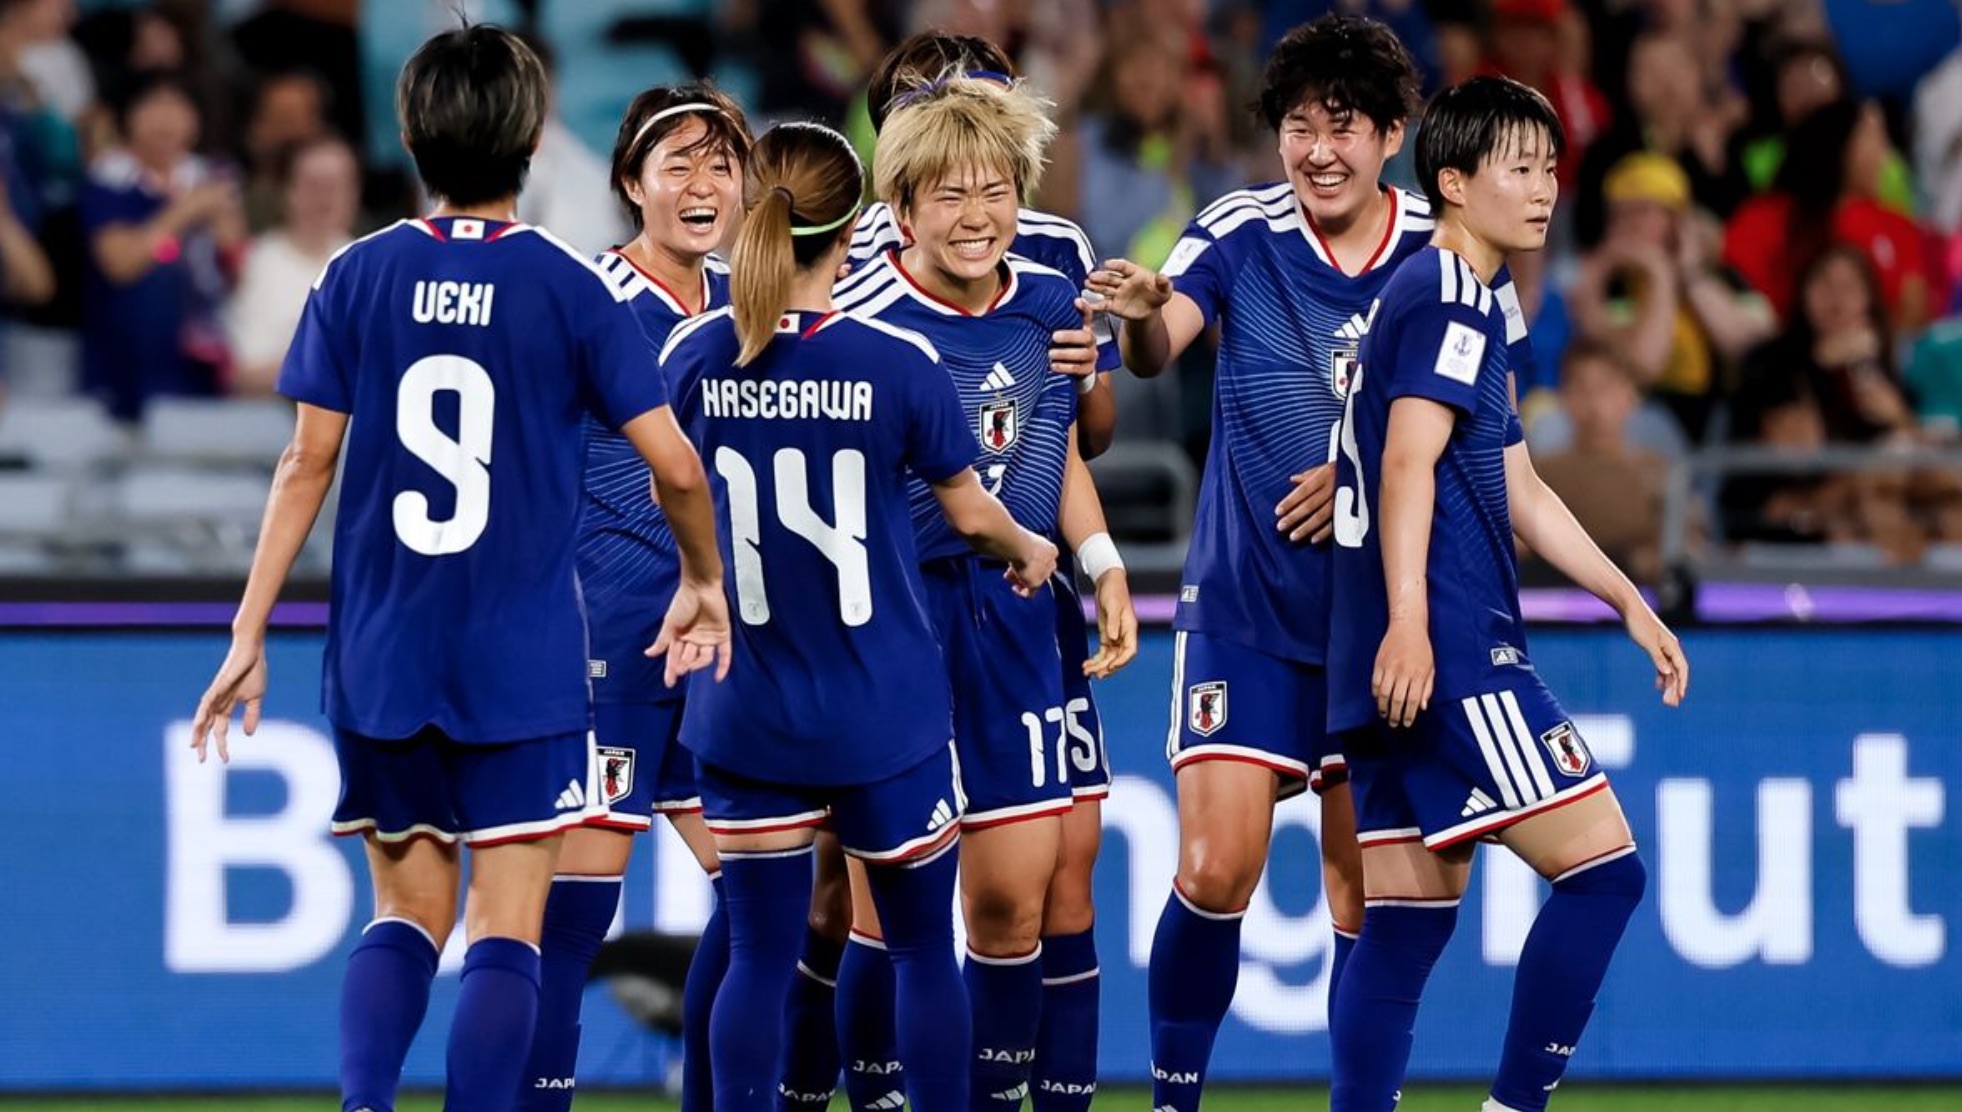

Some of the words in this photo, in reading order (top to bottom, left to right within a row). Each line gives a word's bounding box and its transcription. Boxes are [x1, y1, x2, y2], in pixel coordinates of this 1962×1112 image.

[413, 281, 494, 326] UEKI
[702, 379, 873, 421] HASEGAWA
[393, 354, 495, 556] 9
[715, 445, 873, 626] 14
[1021, 706, 1067, 787] 17
[853, 1060, 903, 1074] JAP
[1041, 1080, 1096, 1094] JAPA
[1151, 1066, 1198, 1084] PAN
